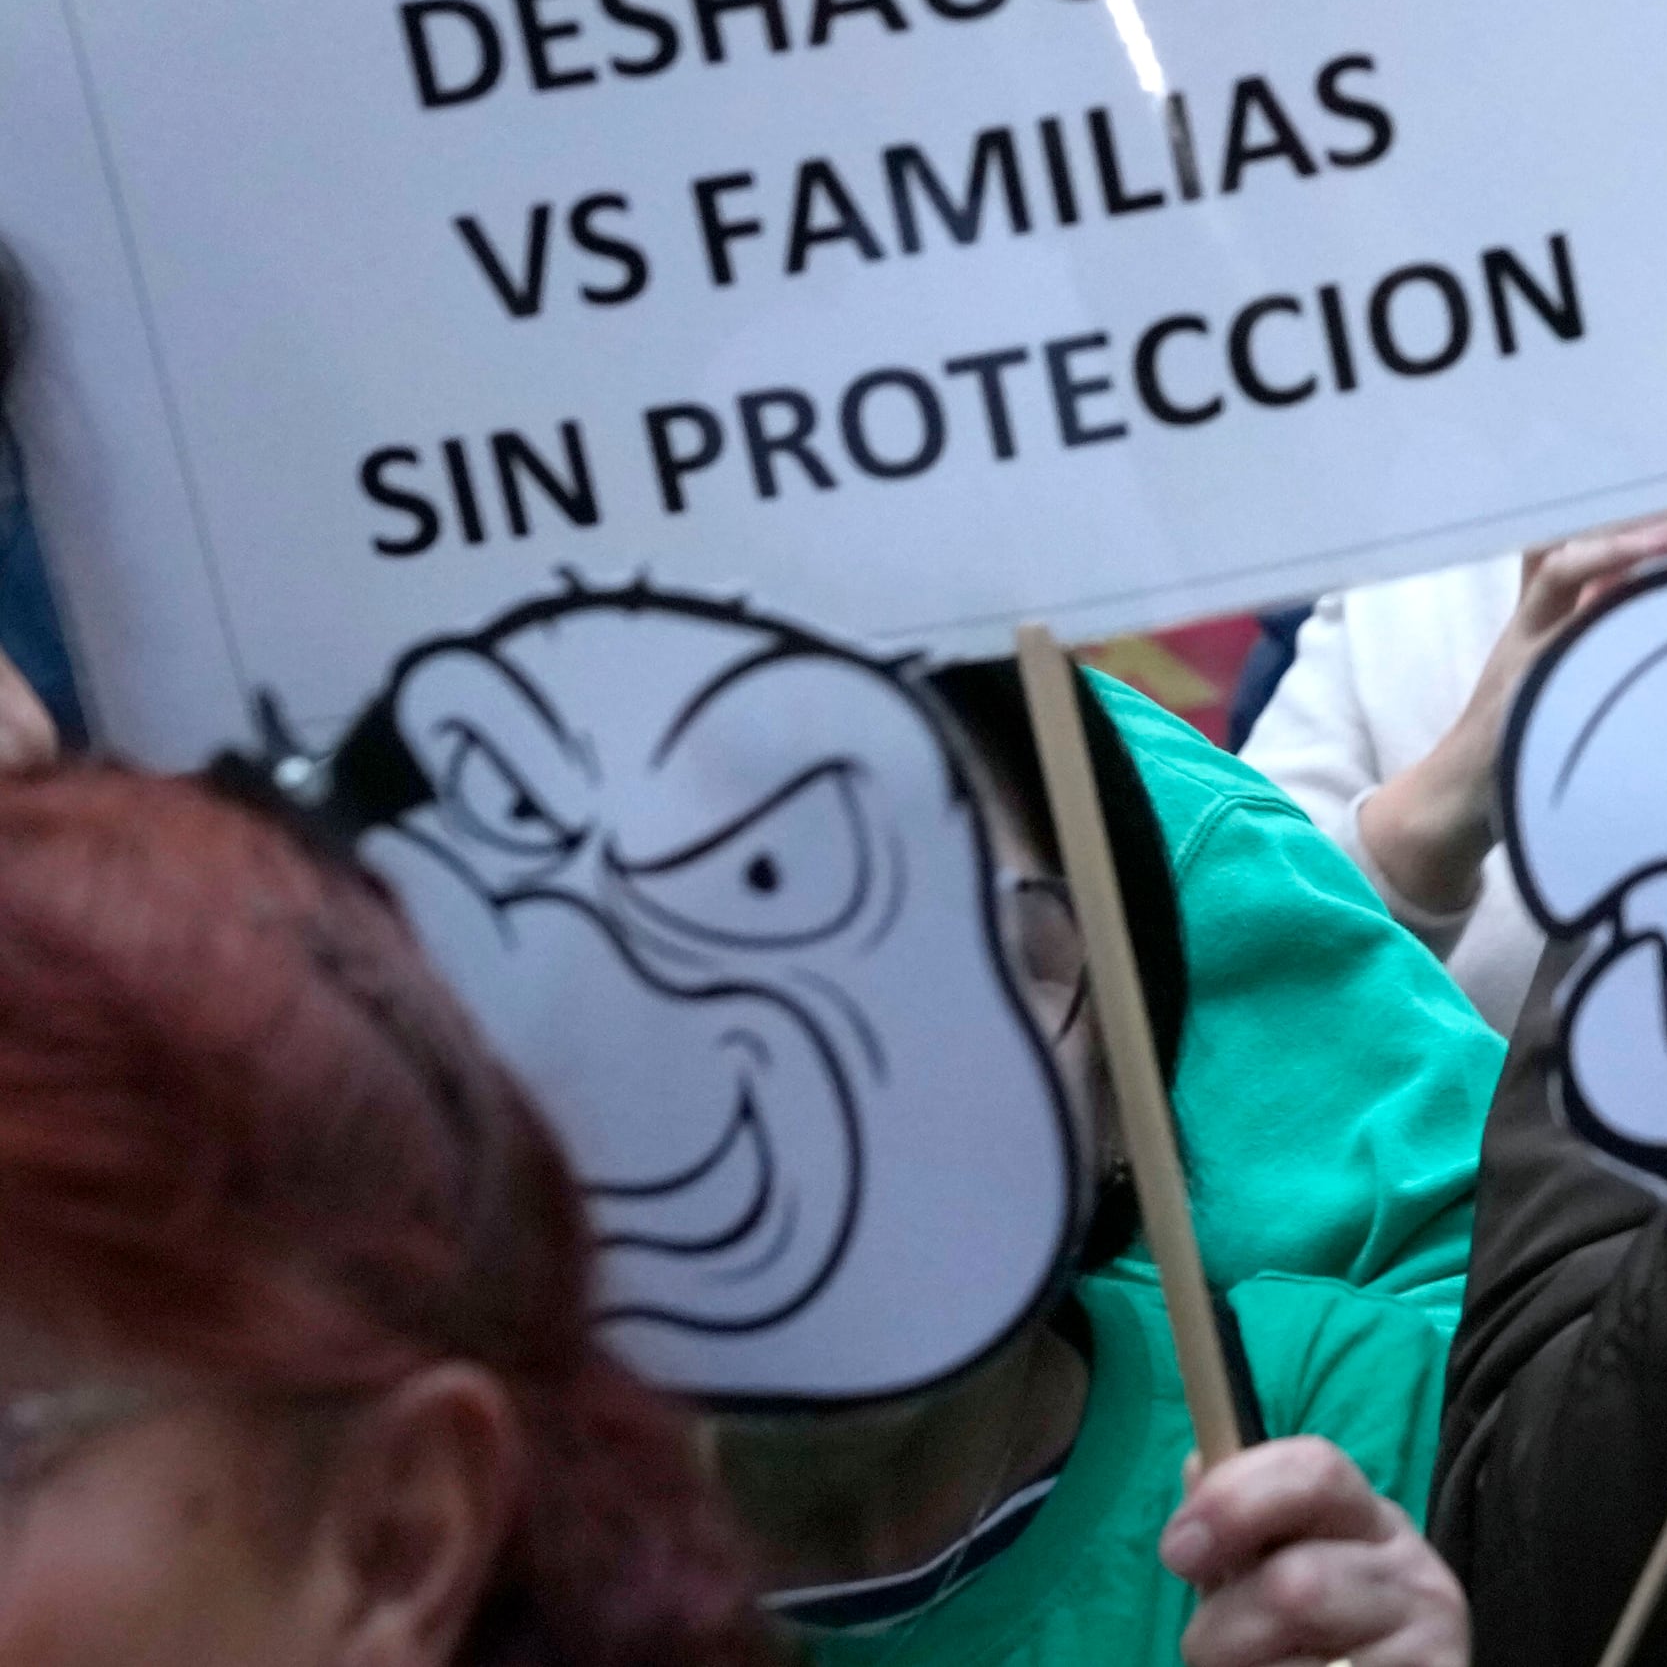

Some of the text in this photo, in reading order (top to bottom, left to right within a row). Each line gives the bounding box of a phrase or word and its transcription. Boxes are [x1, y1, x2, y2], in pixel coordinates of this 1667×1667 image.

[454, 54, 1394, 320] VS FAMILIAS
[358, 233, 1585, 560] SIN PROTECCION
